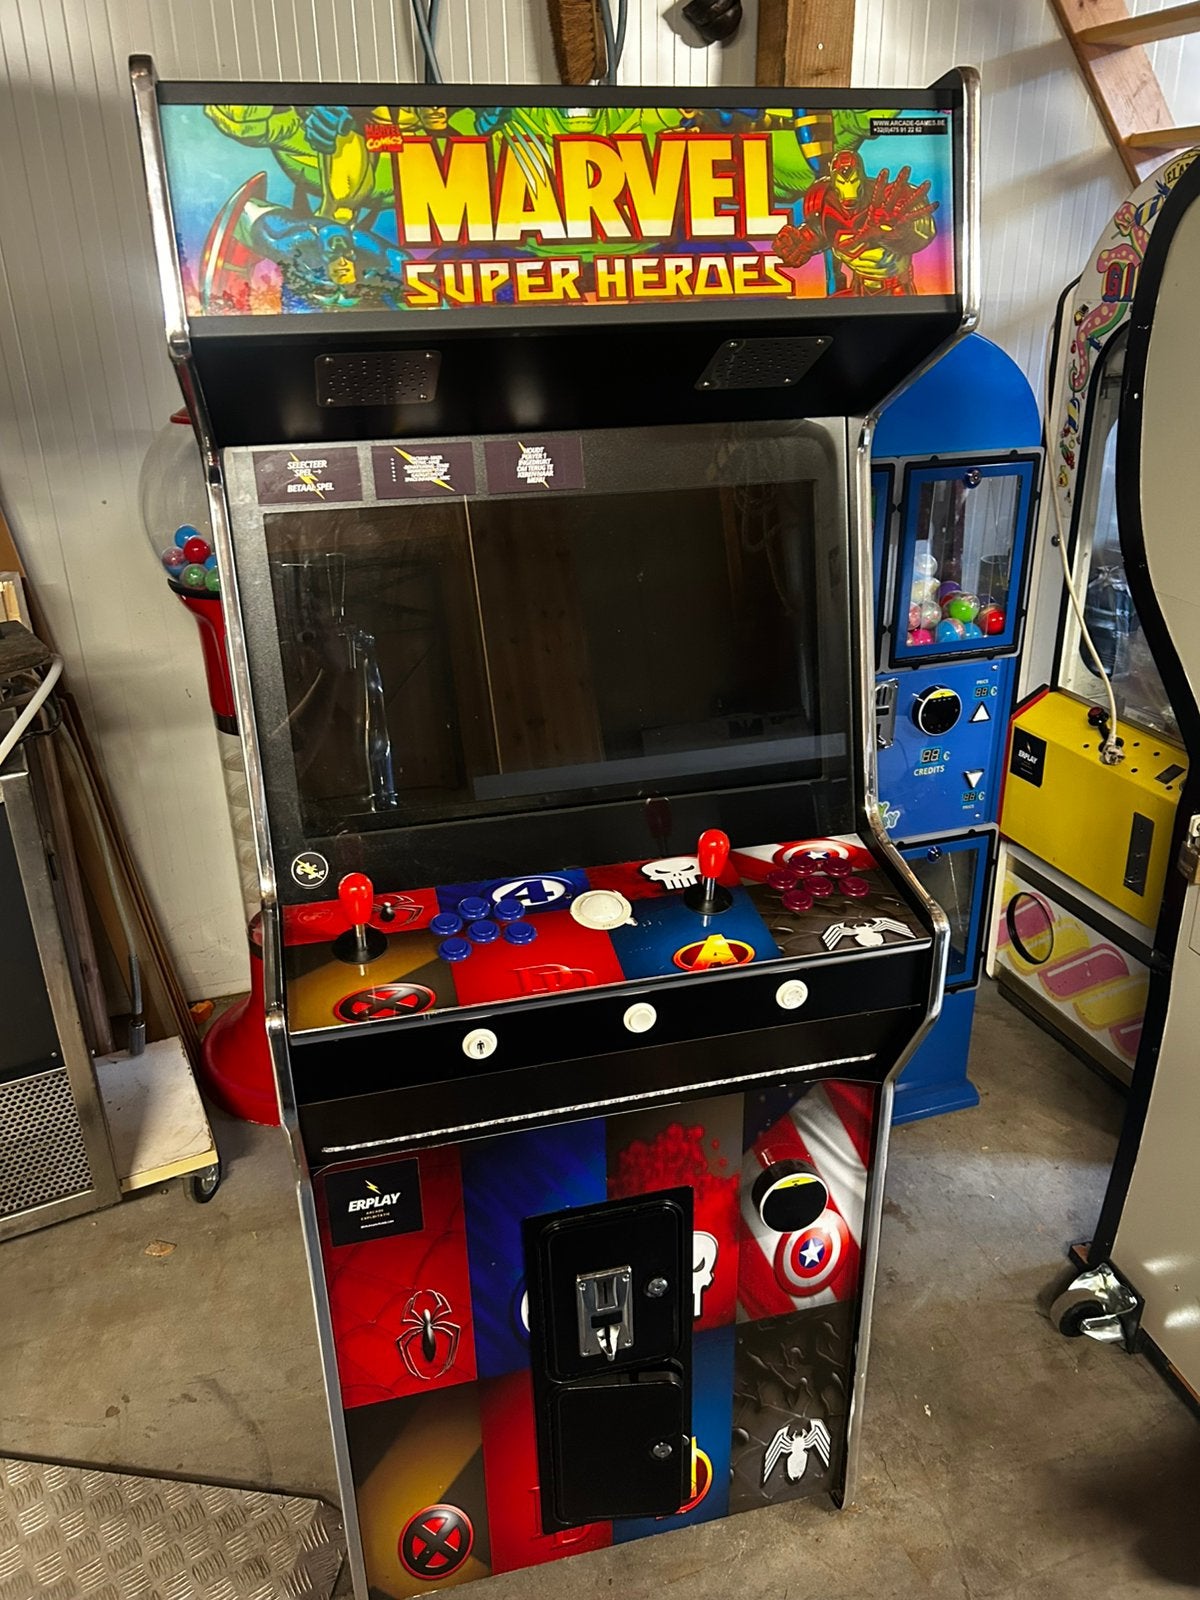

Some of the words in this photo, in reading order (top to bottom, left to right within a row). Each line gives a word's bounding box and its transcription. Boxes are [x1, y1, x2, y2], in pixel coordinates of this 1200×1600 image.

[395, 135, 793, 245] MARVEL
[403, 256, 583, 306] SUPER
[595, 254, 794, 301] HEROES
[287, 459, 328, 469] SELECTEER
[294, 468, 312, 477] SPEL
[287, 483, 316, 493] BETAAL
[316, 482, 335, 491] SPEL
[913, 765, 945, 777] CREDITS
[348, 1191, 402, 1213] ERPLAY
[360, 1212, 391, 1221] EXPLOITATIE
